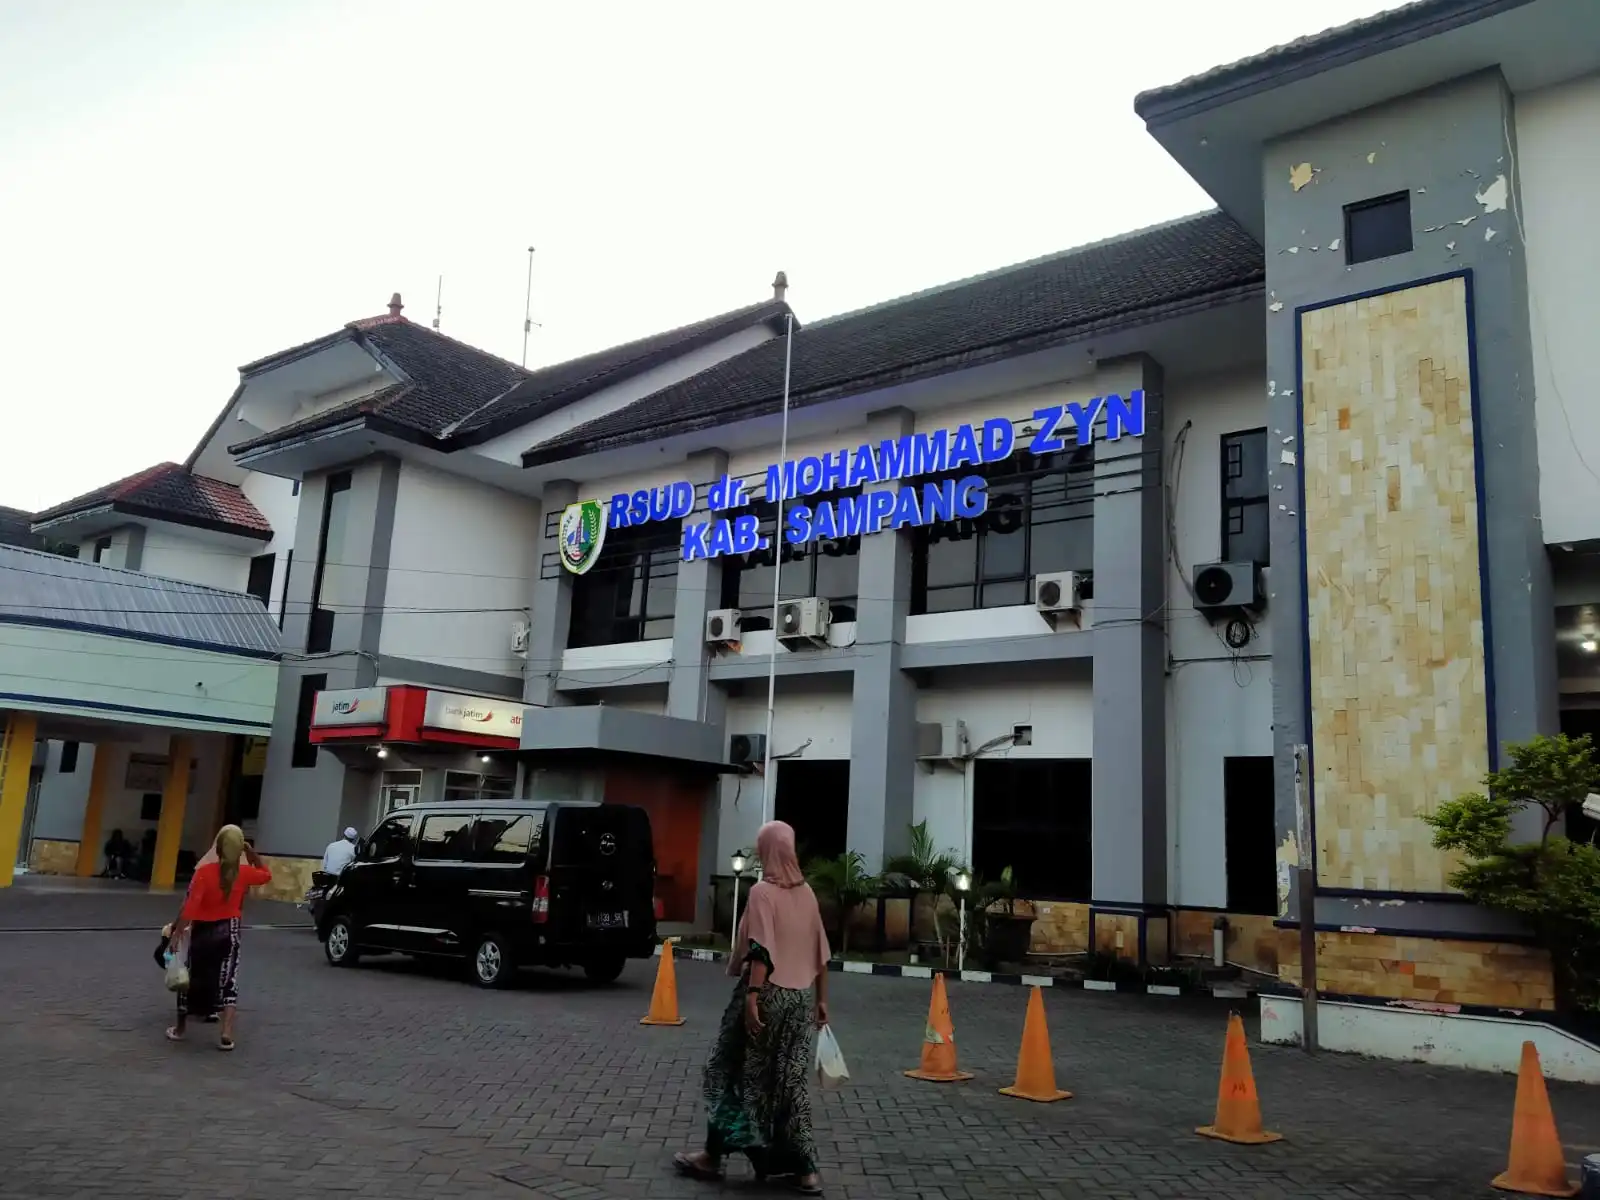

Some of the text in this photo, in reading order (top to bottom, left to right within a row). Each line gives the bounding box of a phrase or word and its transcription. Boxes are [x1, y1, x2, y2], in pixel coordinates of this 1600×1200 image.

[609, 390, 1146, 528] RSUD dr. MOHAMMAD ZYN
[681, 475, 988, 562] KAB. SAMPANG
[332, 700, 350, 714] jatim
